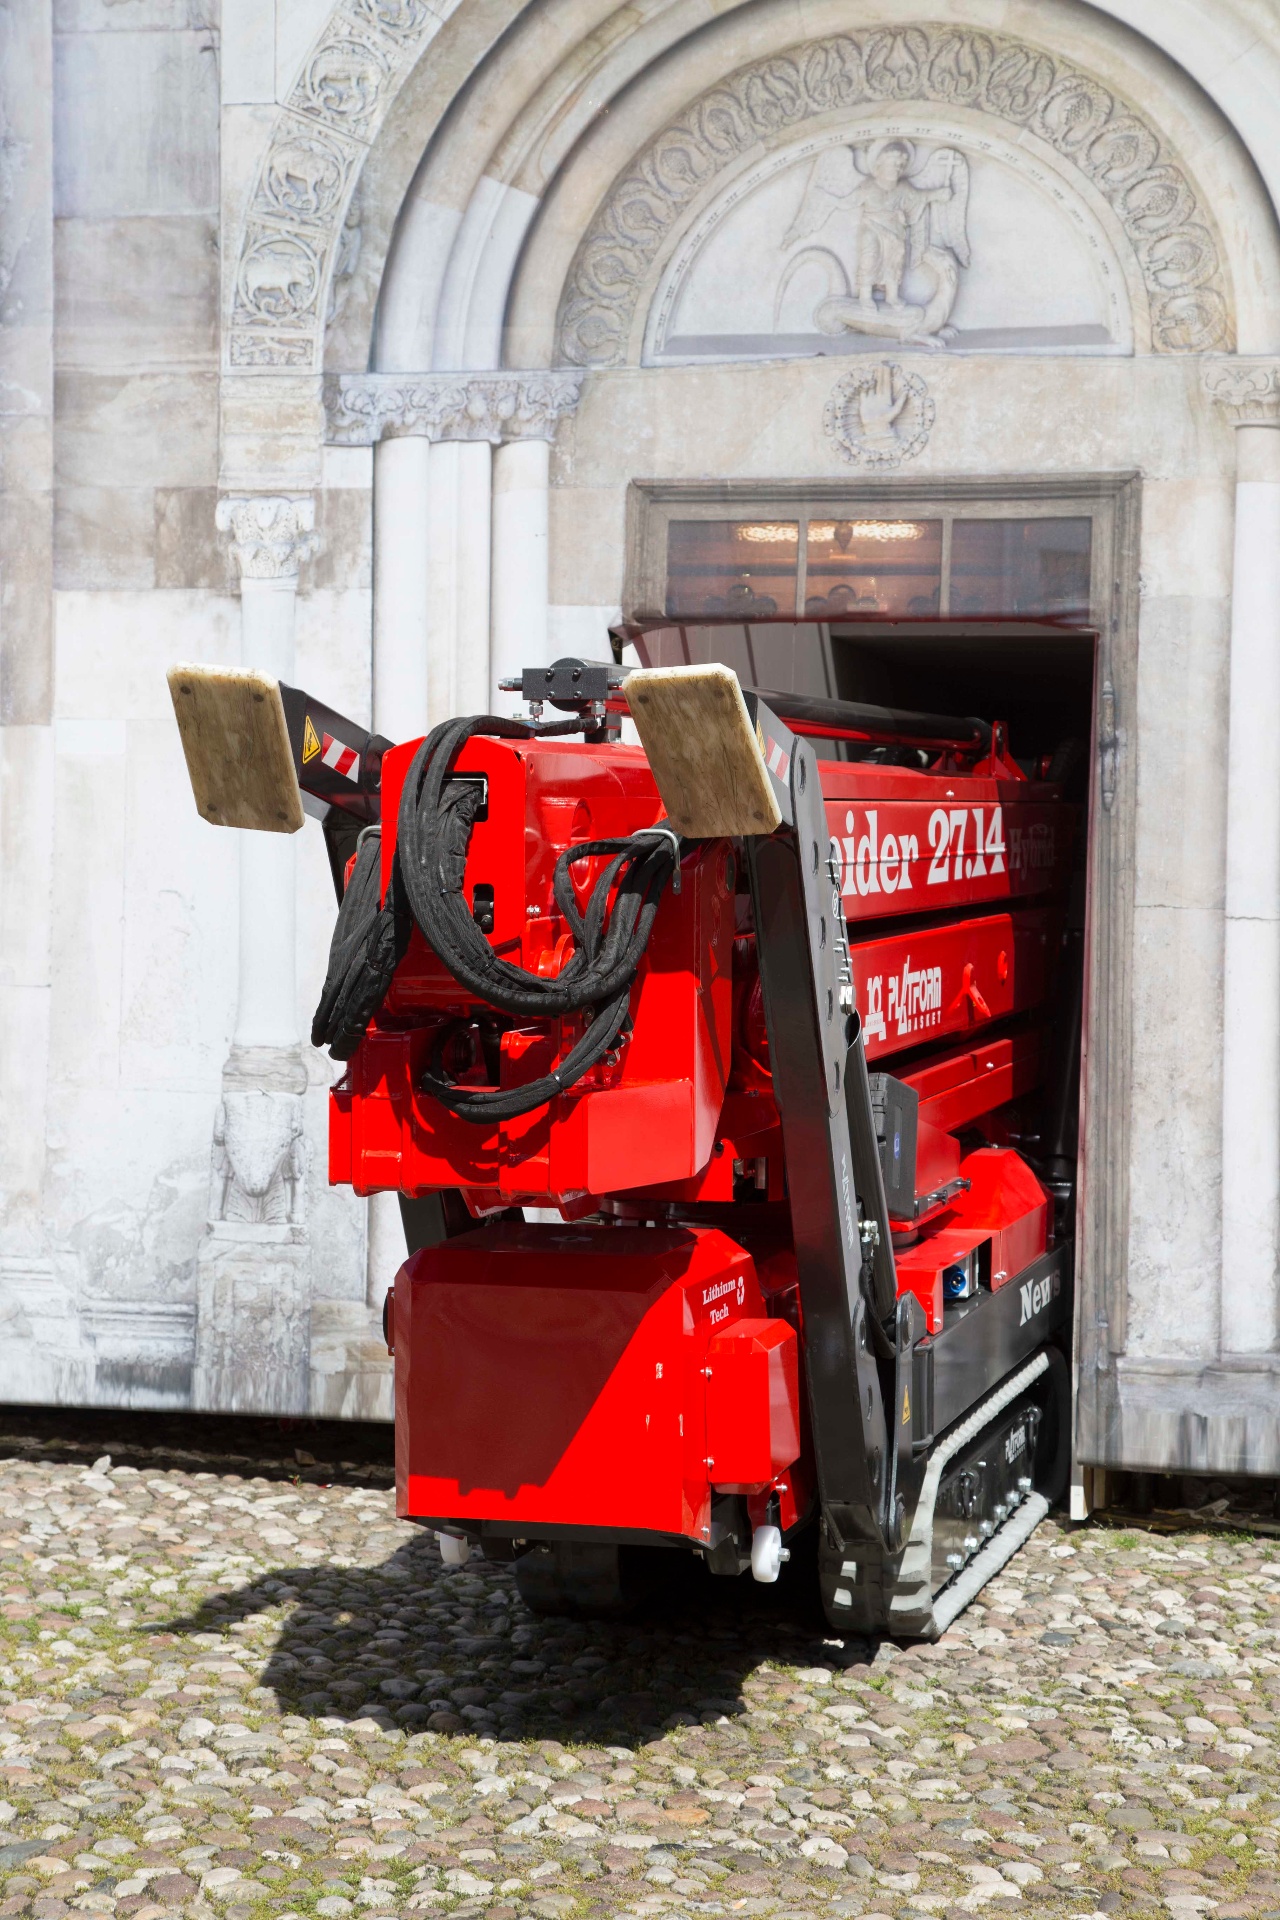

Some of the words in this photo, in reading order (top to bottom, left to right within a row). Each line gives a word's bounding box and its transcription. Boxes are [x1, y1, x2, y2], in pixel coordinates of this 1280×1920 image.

[927, 807, 1006, 885] 27.14
[888, 954, 942, 1035] PLATFORM
[907, 1010, 941, 1033] BASKET
[702, 1279, 737, 1306] Lithium
[709, 1303, 730, 1326] Tech
